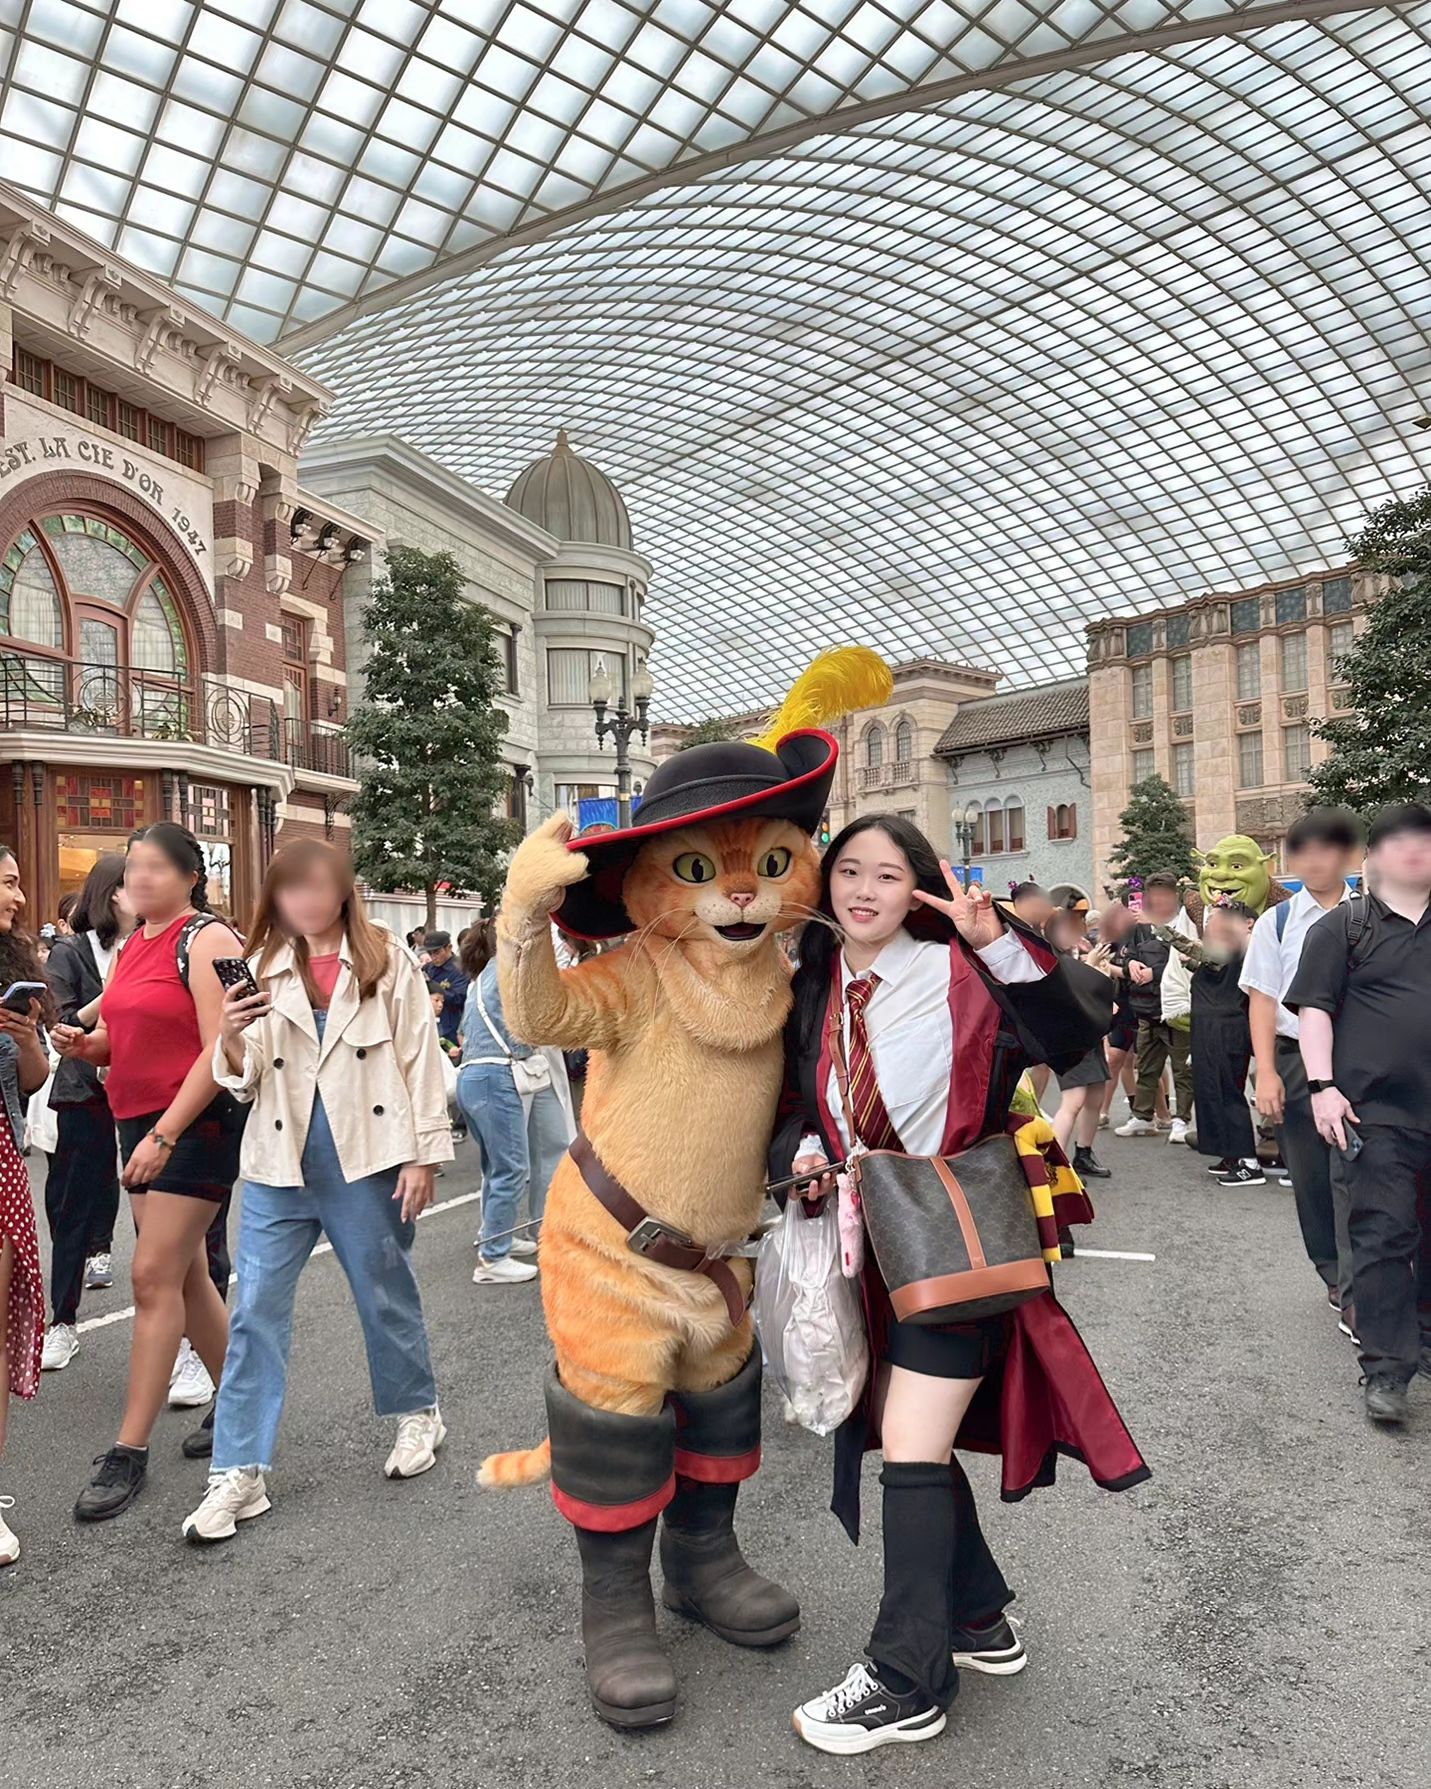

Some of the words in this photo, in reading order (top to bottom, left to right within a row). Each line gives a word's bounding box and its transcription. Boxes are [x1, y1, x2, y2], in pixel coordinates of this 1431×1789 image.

[38, 437, 71, 458] LA
[78, 440, 114, 470] CIE
[122, 458, 164, 506] D'OR
[171, 507, 207, 556] 1947
